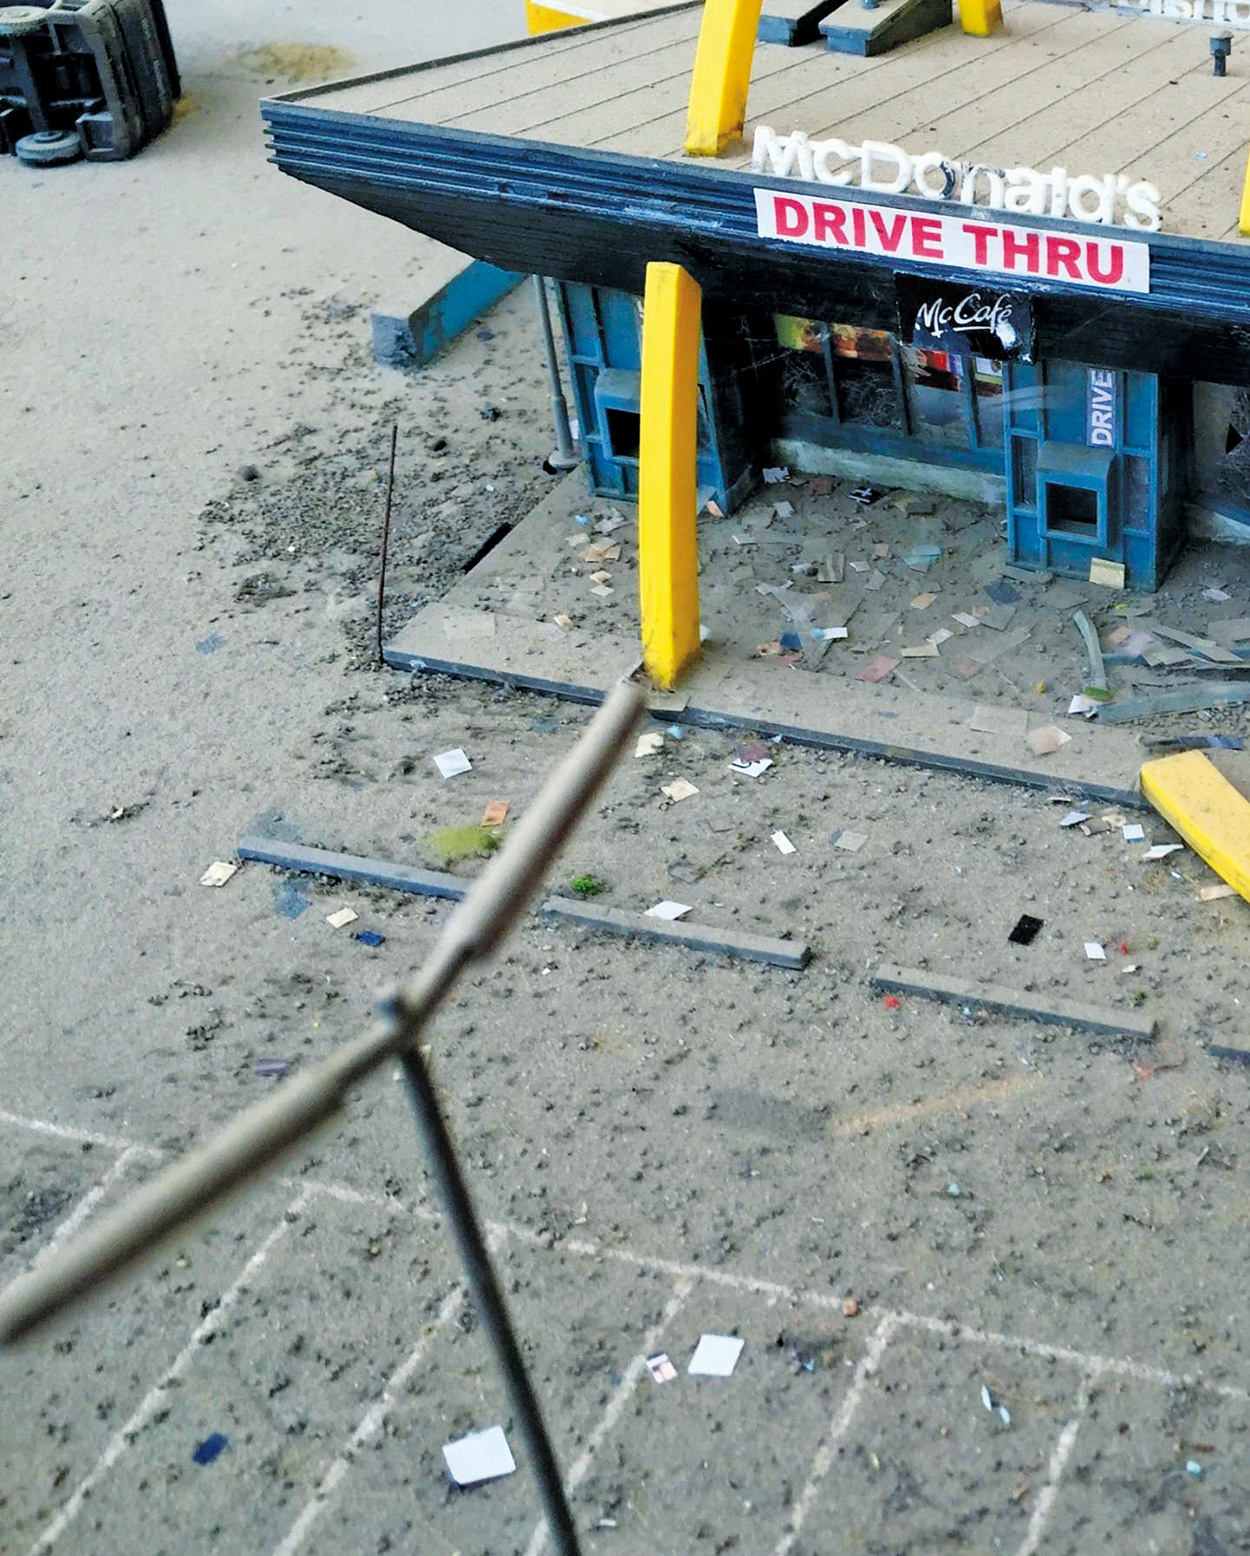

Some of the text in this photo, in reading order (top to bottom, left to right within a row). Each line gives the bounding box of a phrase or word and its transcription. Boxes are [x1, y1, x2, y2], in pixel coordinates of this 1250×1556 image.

[752, 125, 1162, 232] McDonald's
[773, 196, 1124, 285] DRIVE THRU
[1090, 370, 1113, 446] DRIVE
